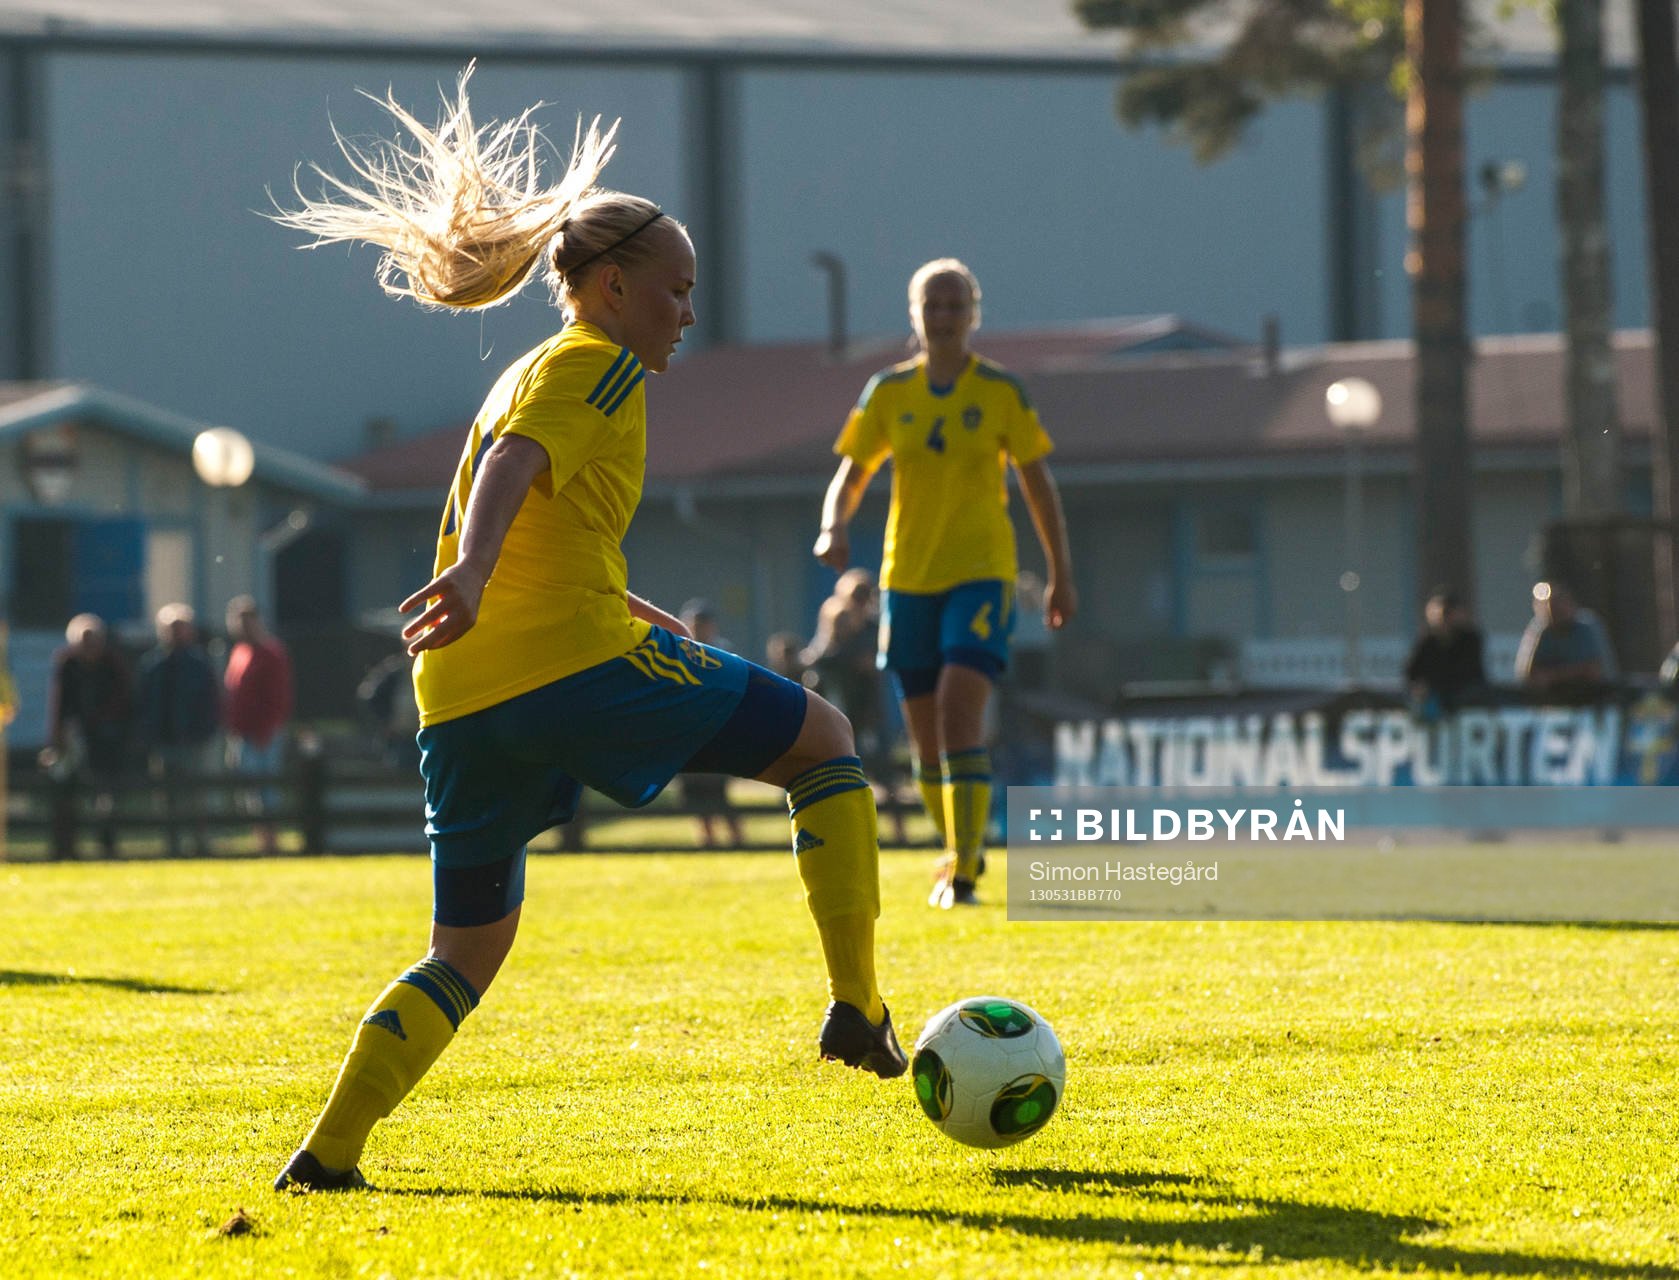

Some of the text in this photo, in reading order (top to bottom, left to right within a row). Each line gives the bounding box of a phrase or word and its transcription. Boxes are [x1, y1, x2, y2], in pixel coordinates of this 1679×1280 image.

[926, 415, 946, 454] 4
[969, 602, 992, 640] 4
[1054, 706, 1620, 796] NATIONALSPORTEN
